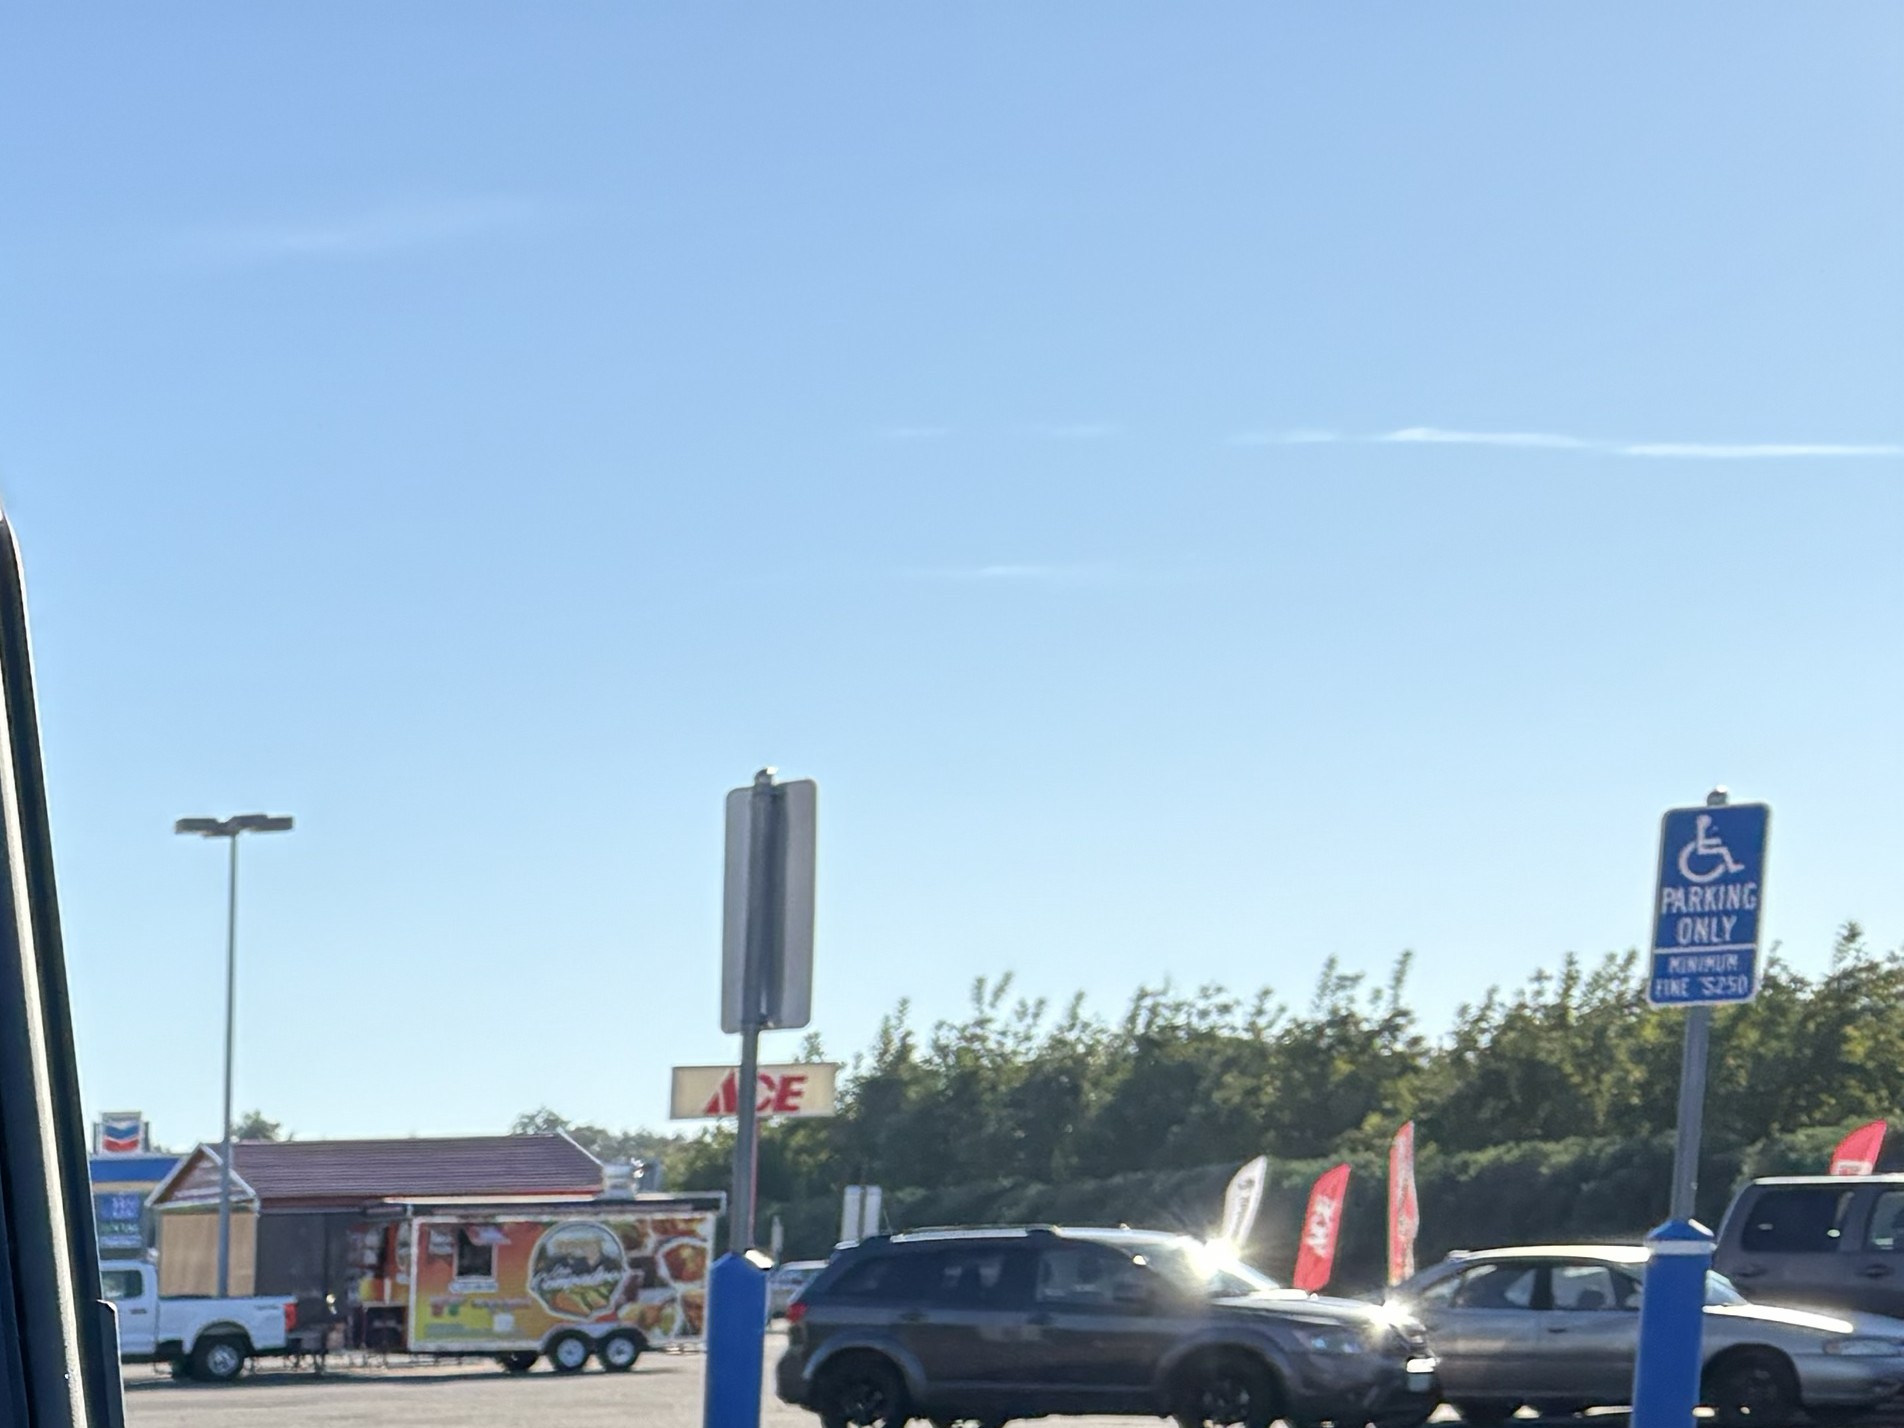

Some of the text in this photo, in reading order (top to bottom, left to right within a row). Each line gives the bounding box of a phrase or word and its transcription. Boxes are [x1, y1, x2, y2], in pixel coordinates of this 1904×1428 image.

[1661, 881, 1758, 915] PARKING
[1676, 914, 1738, 945] ONLY
[1667, 953, 1739, 974] MINIMUM
[1654, 977, 1690, 998] FINE
